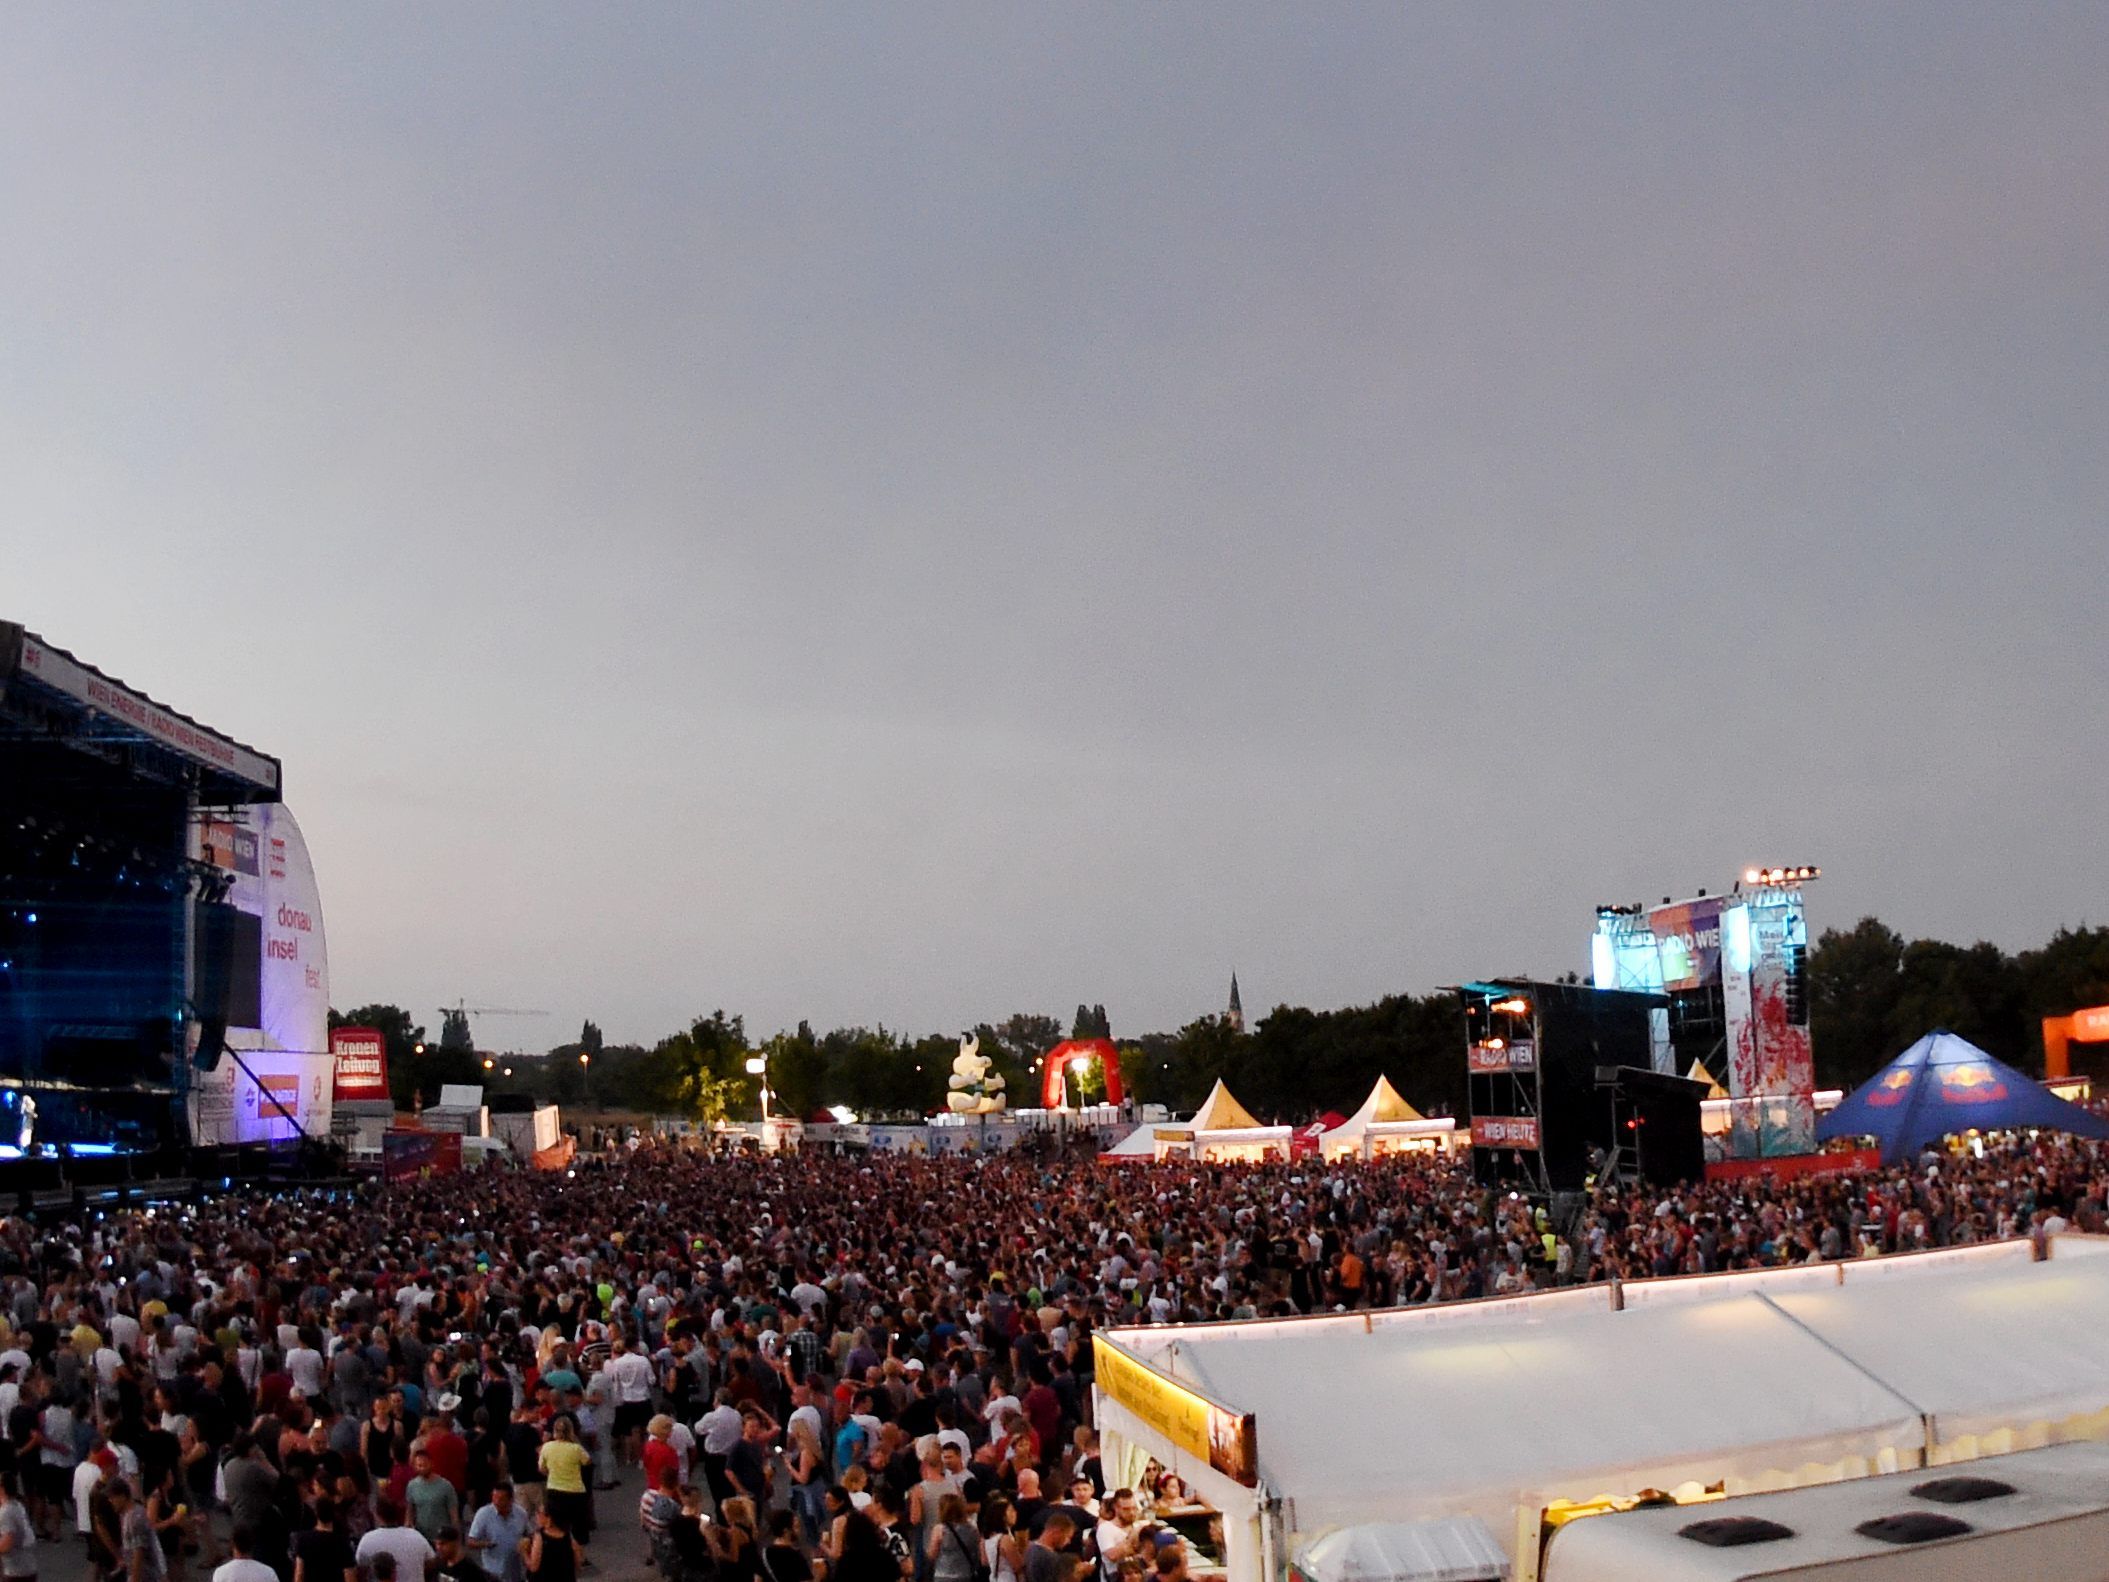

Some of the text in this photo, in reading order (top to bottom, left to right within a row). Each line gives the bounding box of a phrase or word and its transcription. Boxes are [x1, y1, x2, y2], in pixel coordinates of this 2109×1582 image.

[278, 902, 312, 931] donau
[267, 933, 298, 960] insel
[1695, 928, 1720, 949] WIE
[336, 1041, 379, 1055] Kronen
[1508, 1045, 1533, 1064] WIEN
[336, 1056, 380, 1074] Zeitung
[1484, 1123, 1536, 1143] WIEN HEUTE
